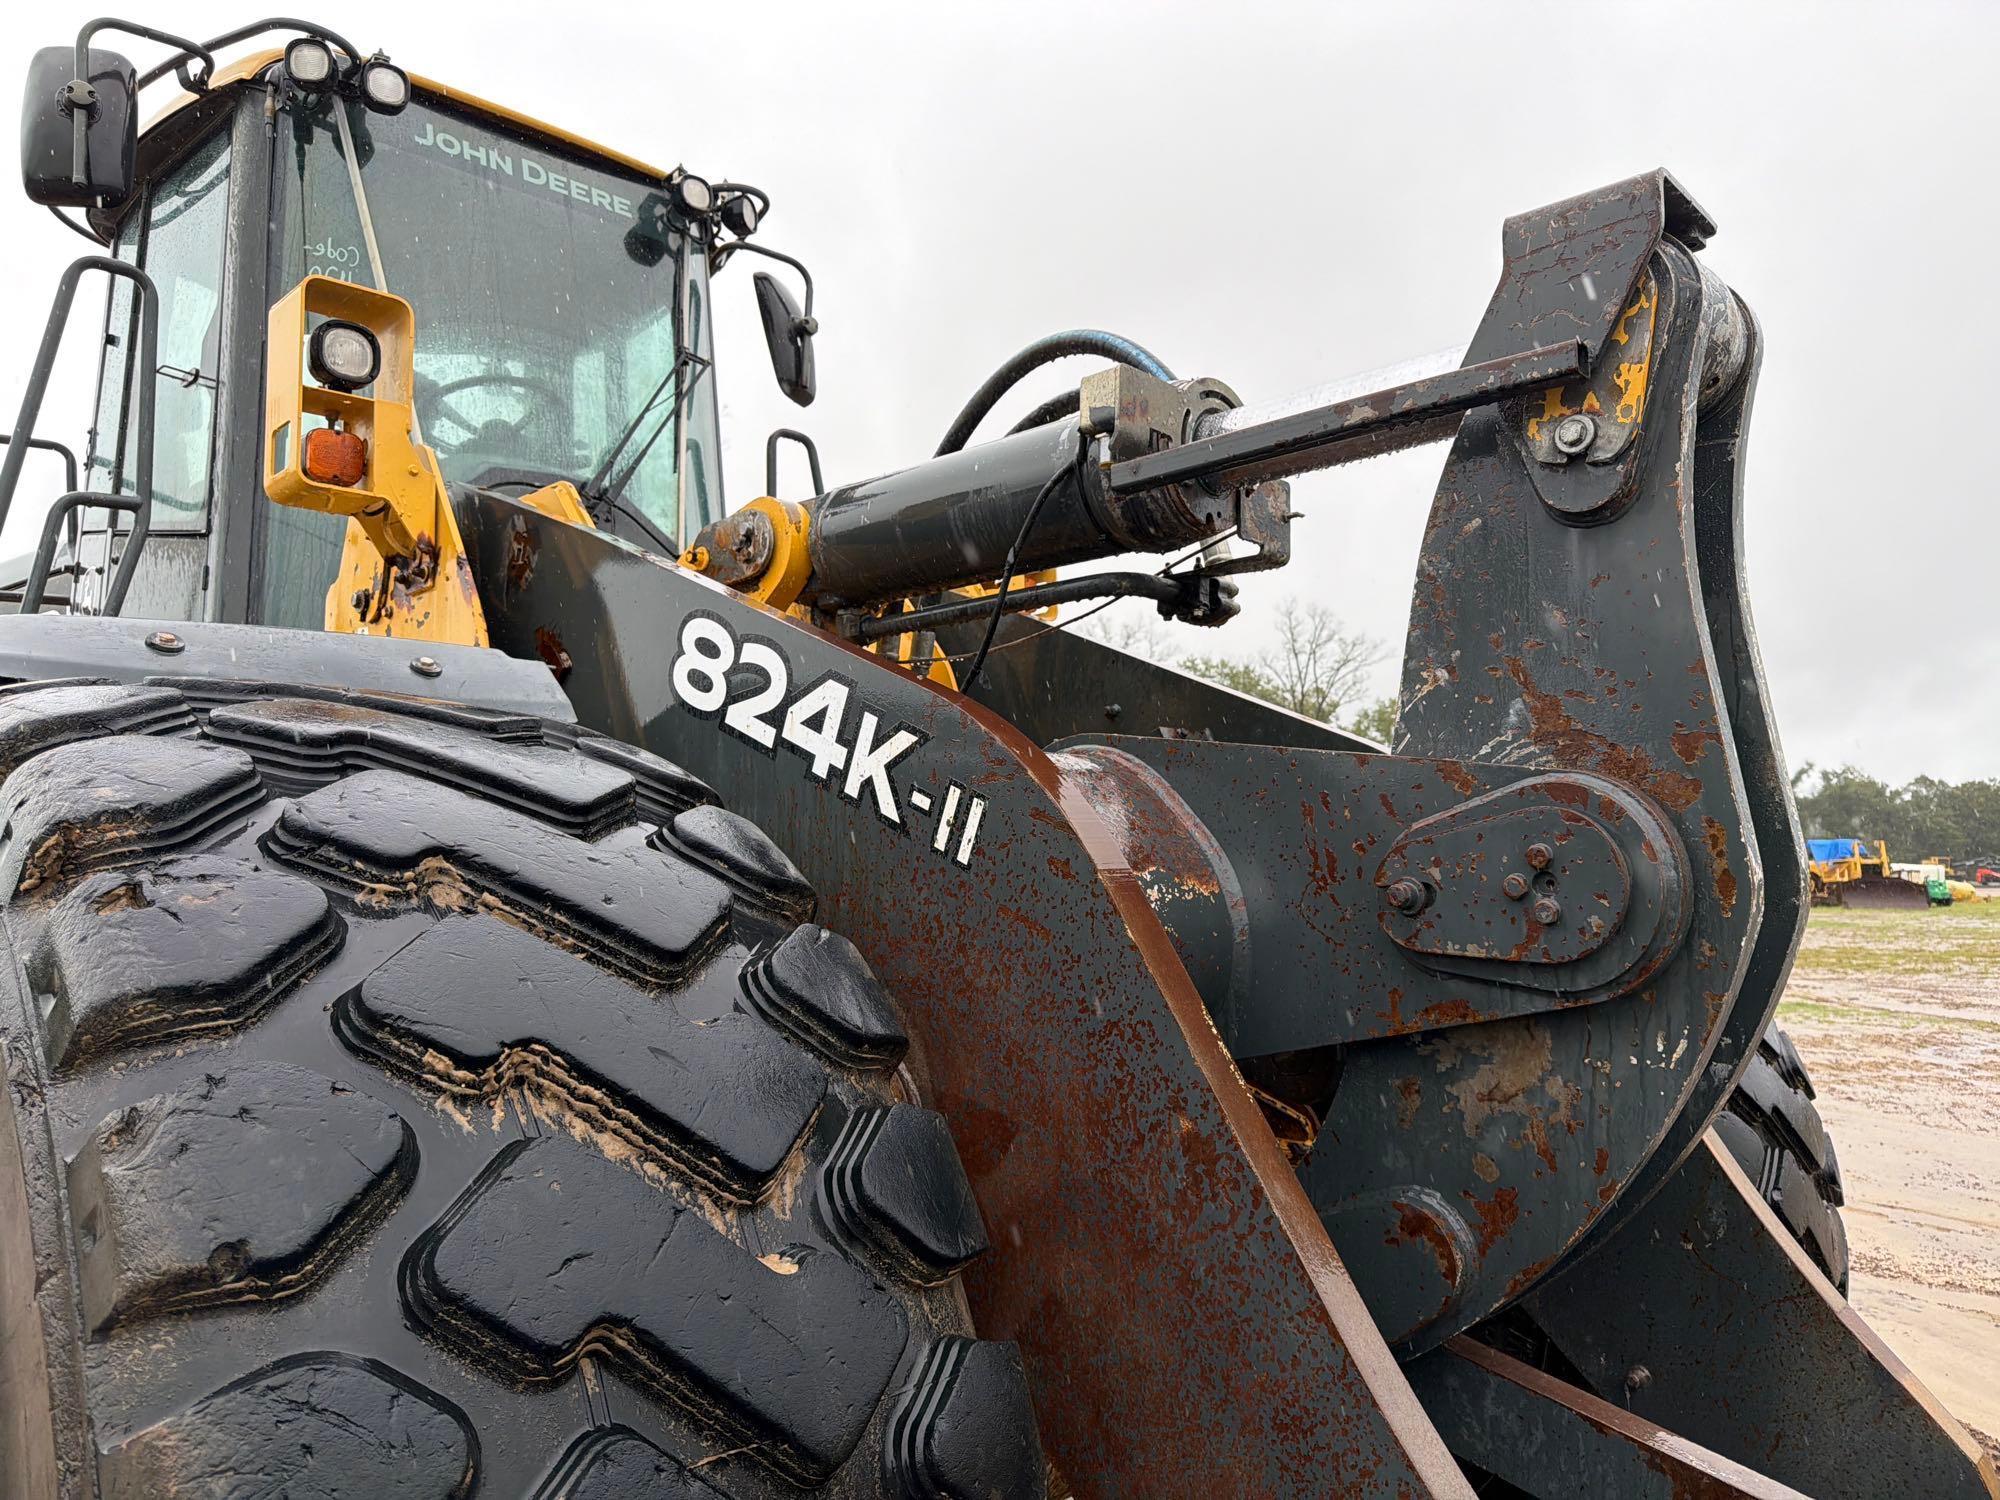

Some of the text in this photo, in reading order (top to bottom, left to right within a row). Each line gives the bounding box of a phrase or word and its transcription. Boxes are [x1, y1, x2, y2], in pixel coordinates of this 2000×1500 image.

[414, 123, 633, 218] JOHN DEERE
[672, 617, 985, 866] 824K-II
